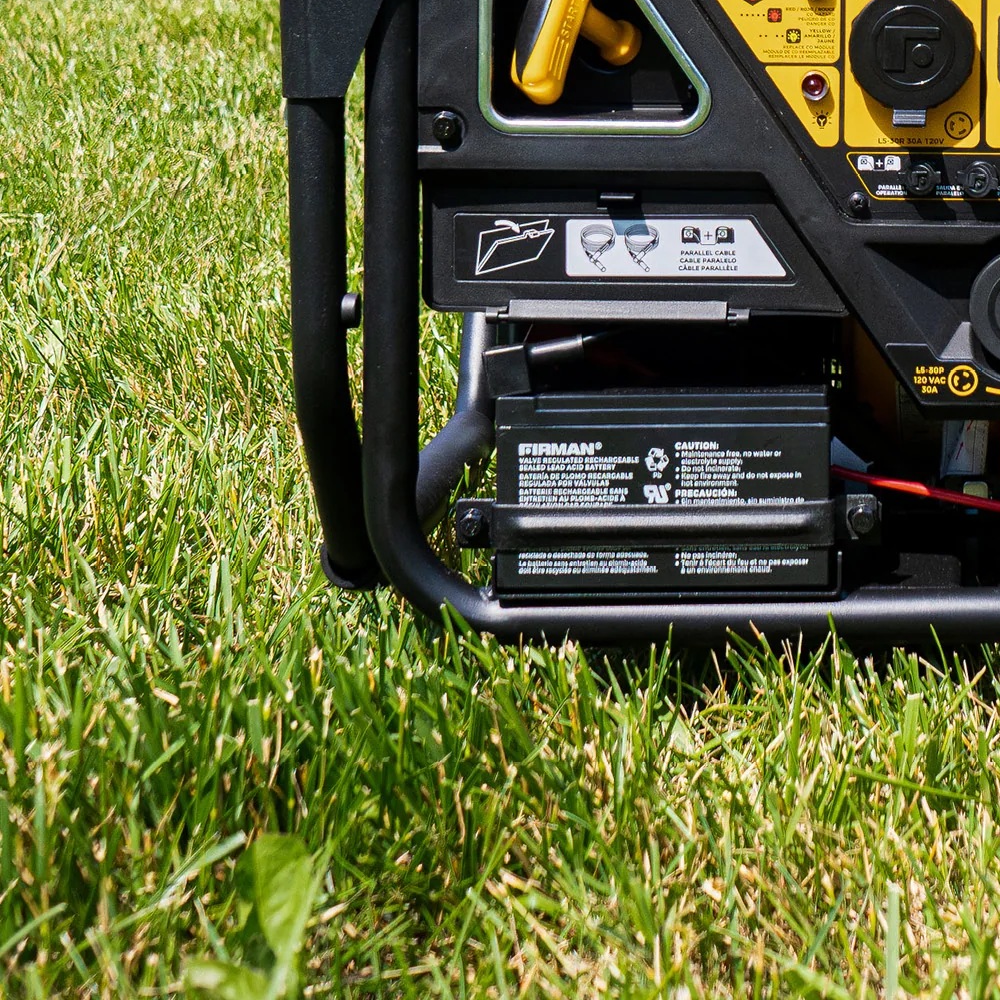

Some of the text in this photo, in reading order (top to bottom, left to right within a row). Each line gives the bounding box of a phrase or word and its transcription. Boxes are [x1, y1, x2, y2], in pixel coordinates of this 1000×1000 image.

[914, 376, 946, 385] 120 VAC
[922, 386, 938, 394] 30A
[675, 442, 719, 450] CAUTION:
[681, 450, 725, 458] Maintenance
[743, 450, 752, 458] no
[753, 450, 773, 458] water
[774, 450, 782, 458] or
[550, 472, 560, 480] DE
[588, 472, 634, 480] RECARGABLE
[681, 472, 802, 480] Keep fire away and do not expose in
[675, 488, 738, 498] PRECAUCIÓN:
